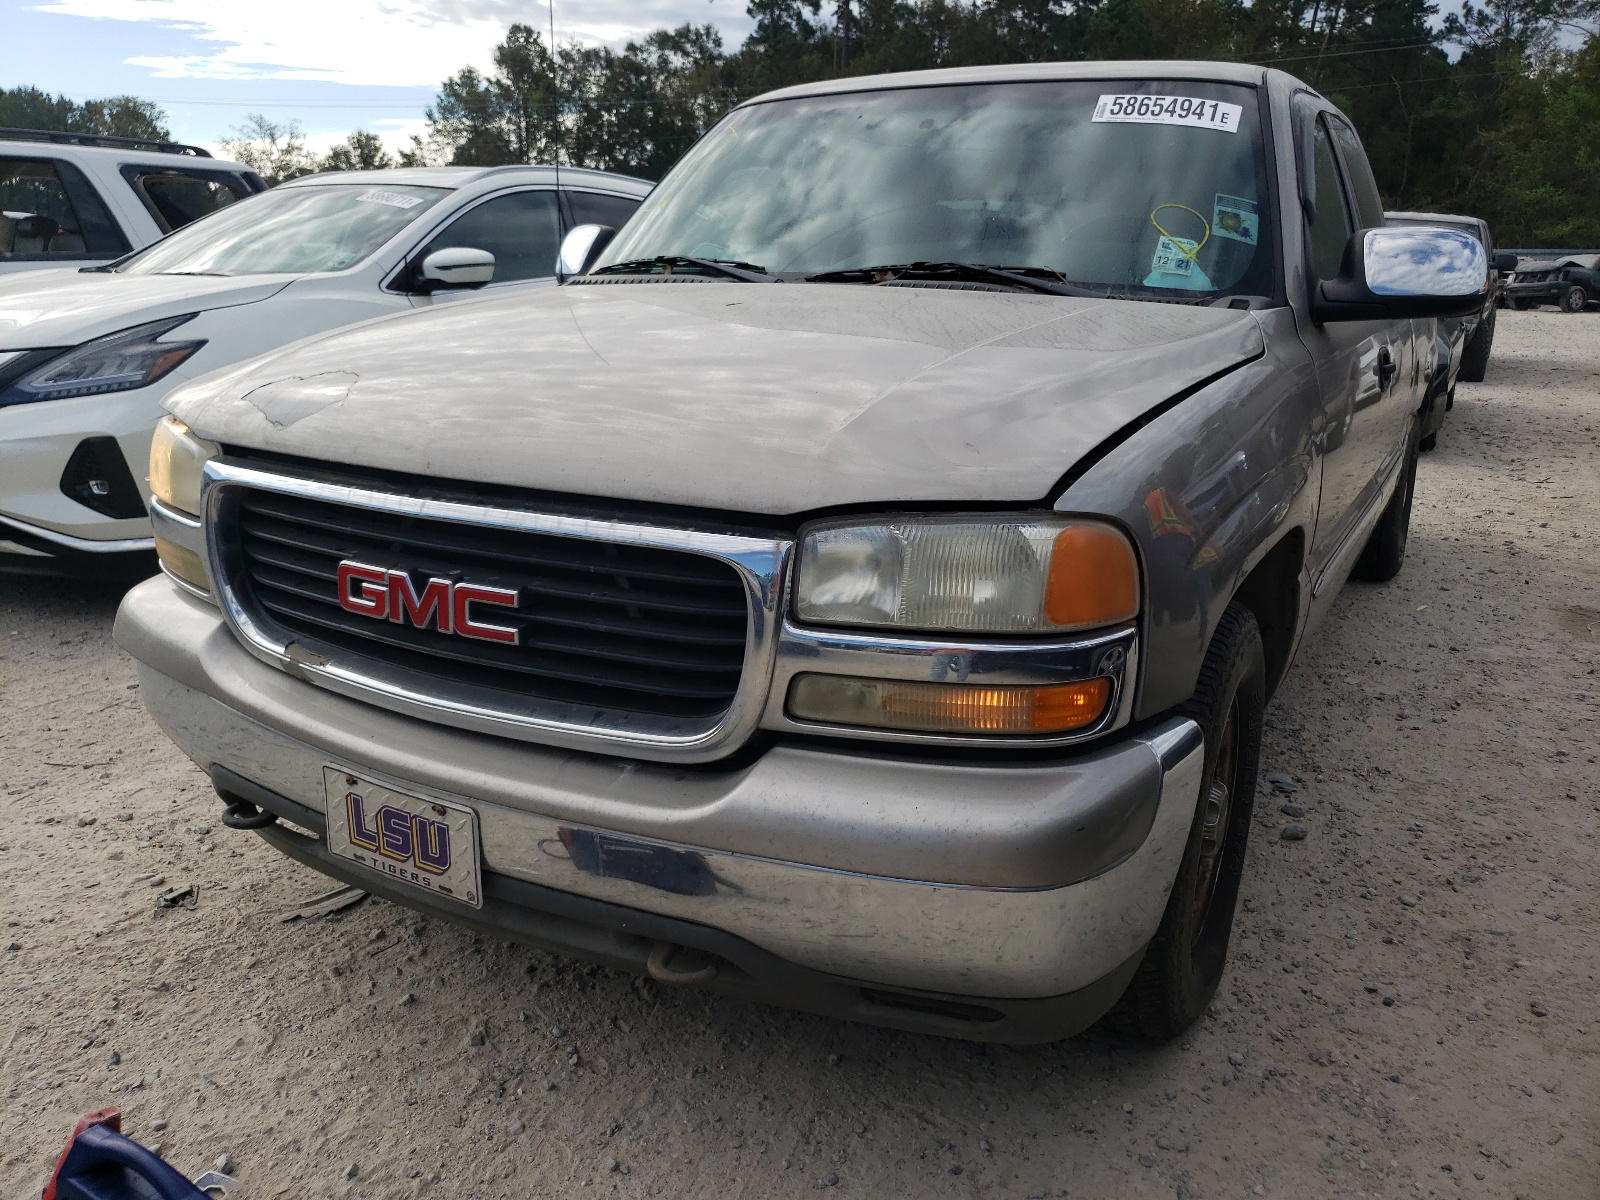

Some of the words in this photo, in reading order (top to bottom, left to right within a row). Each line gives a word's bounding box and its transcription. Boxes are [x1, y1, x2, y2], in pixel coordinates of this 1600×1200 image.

[1110, 96, 1219, 122] 58654941
[1157, 256, 1170, 265] 12
[1177, 259, 1190, 269] 21
[337, 560, 519, 646] GMC
[346, 792, 451, 876] LSU
[371, 857, 432, 887] TIGERS
